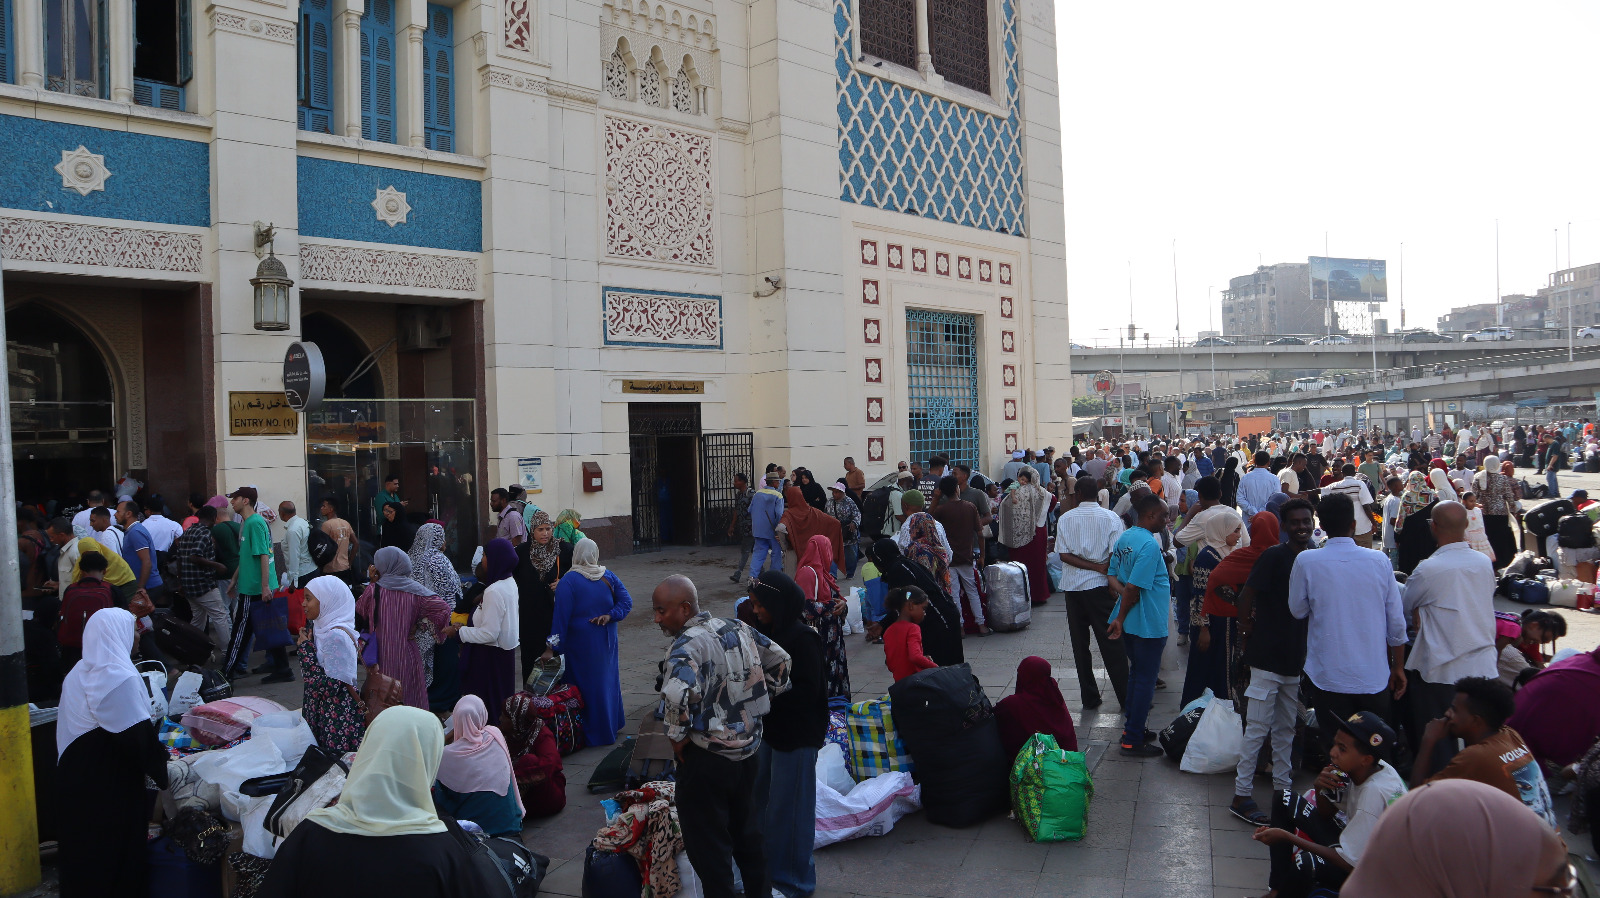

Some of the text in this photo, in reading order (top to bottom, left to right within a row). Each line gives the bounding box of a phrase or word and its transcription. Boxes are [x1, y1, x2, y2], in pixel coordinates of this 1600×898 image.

[1097, 380, 1110, 391] M
[247, 398, 264, 410] رقم
[267, 399, 291, 410] دخل
[234, 418, 294, 428] ENTRY NO. (1)
